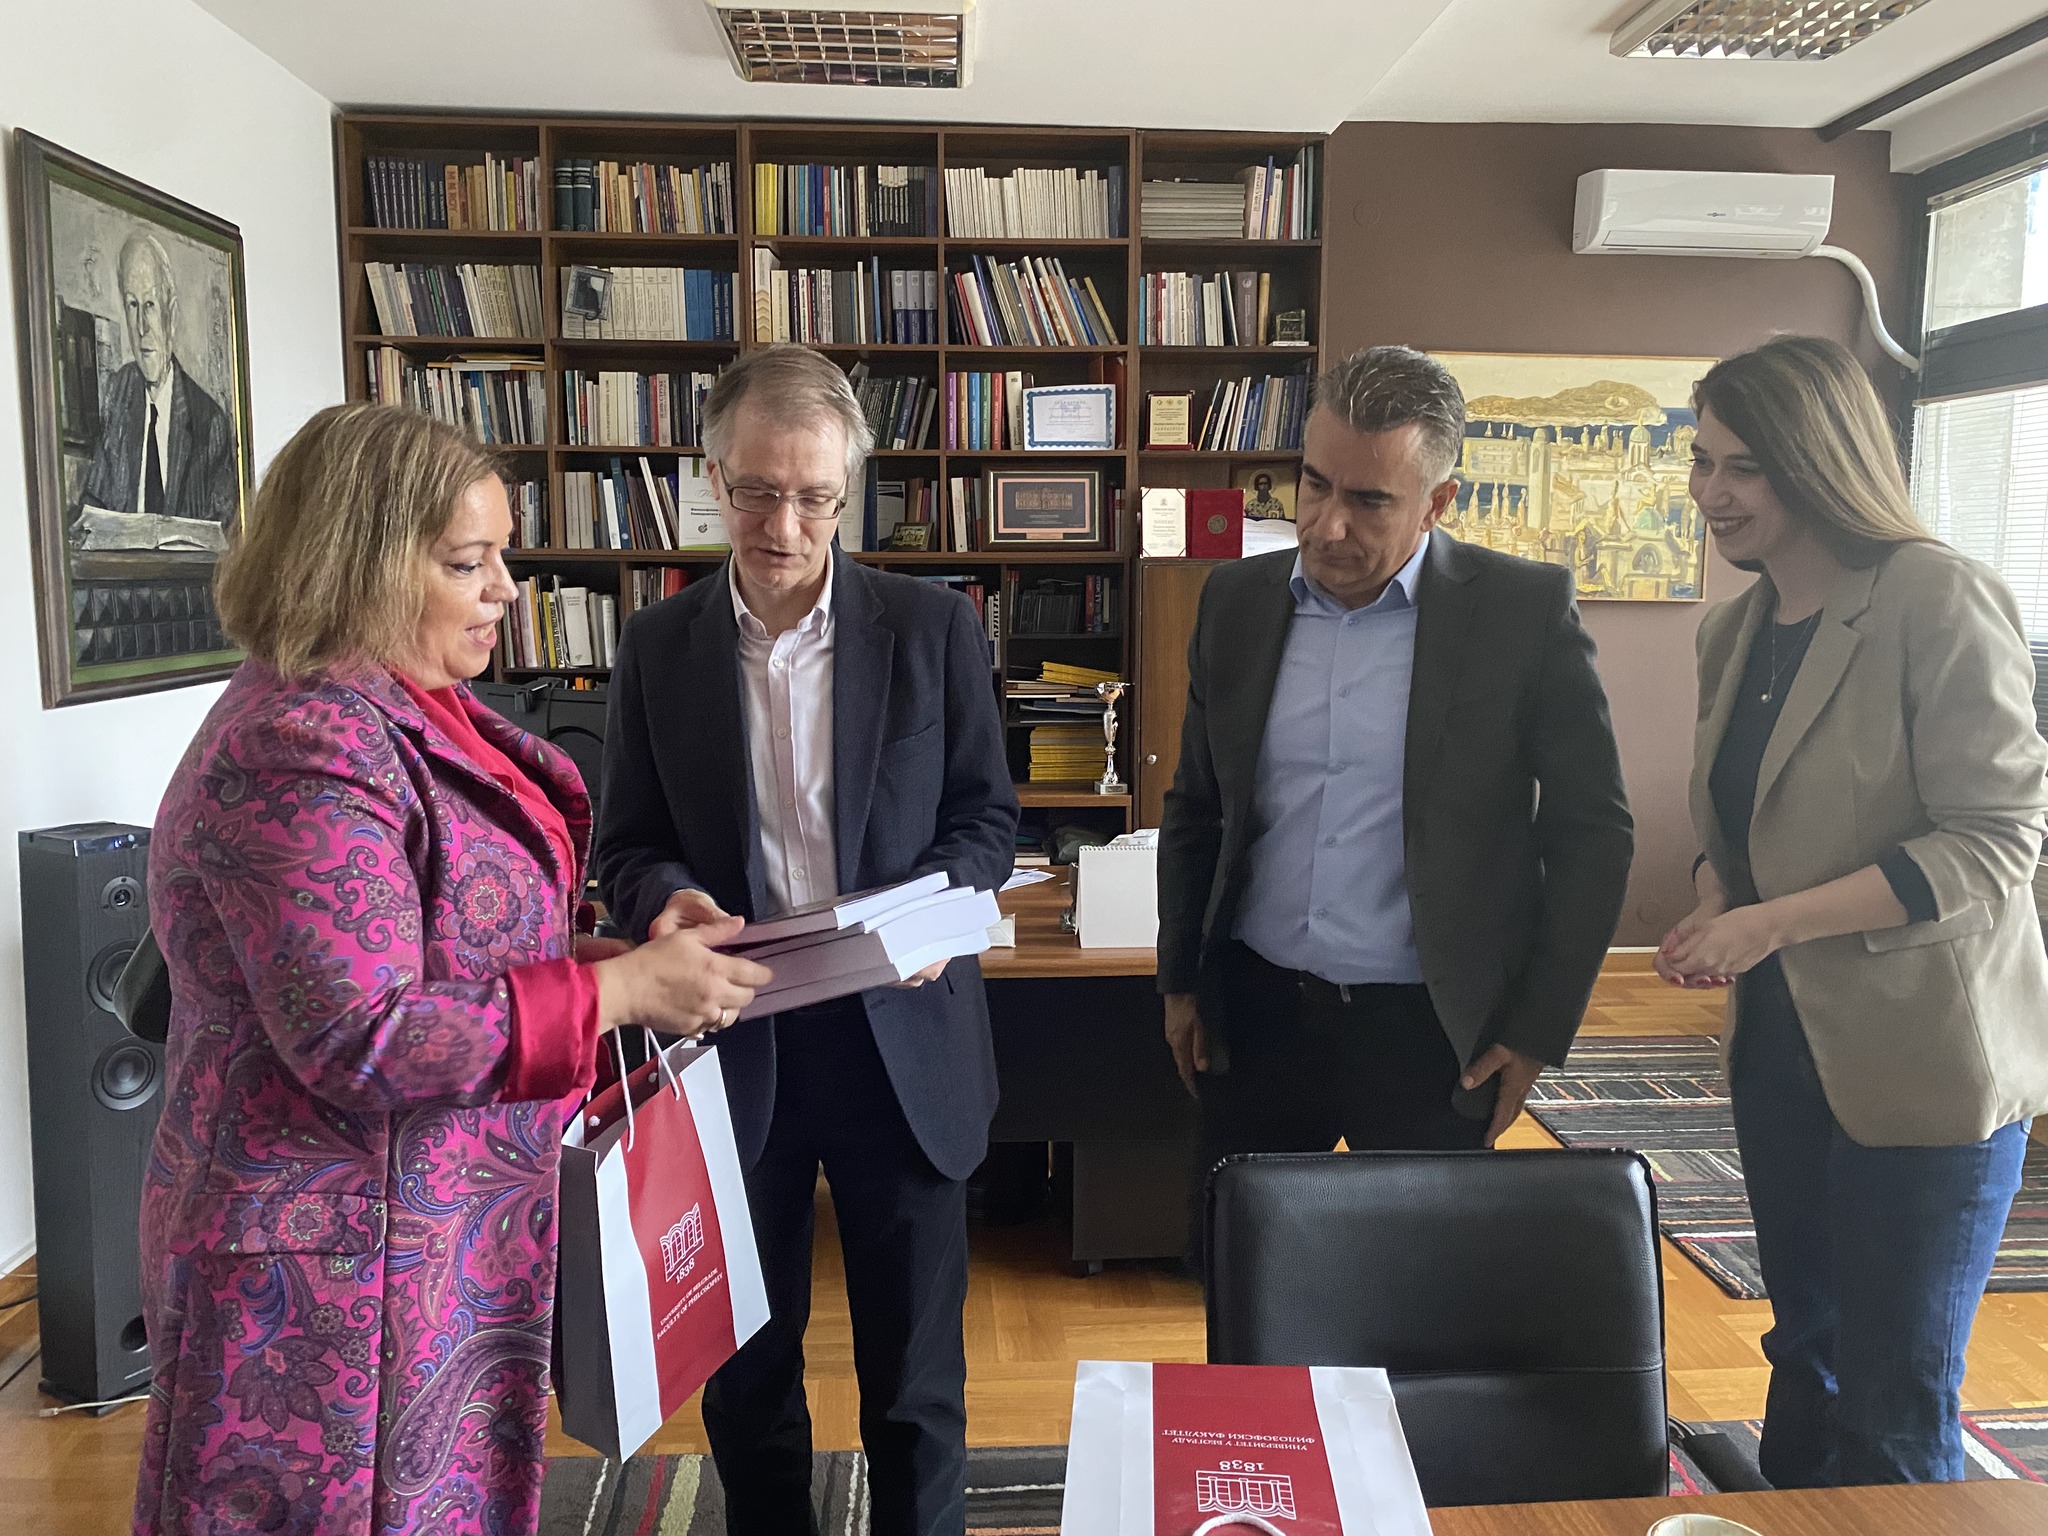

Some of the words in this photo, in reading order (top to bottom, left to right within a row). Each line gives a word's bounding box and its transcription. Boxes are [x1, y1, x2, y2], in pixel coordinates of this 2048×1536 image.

[675, 1258, 695, 1284] 1838
[660, 1297, 685, 1325] UNIVERSITY
[692, 1268, 719, 1291] BELGRADE
[657, 1313, 680, 1340] FACULTY
[688, 1273, 723, 1308] PHILOSOPHY
[1162, 1429, 1225, 1440] ФАКУЛТЕТ
[1228, 1430, 1315, 1444] ФИЛОЗОФСКИ
[1172, 1438, 1222, 1446] БЕОГРАДУ
[1233, 1440, 1308, 1451] УНИВЕРЗИТЕТ
[1219, 1460, 1265, 1473] 1838
